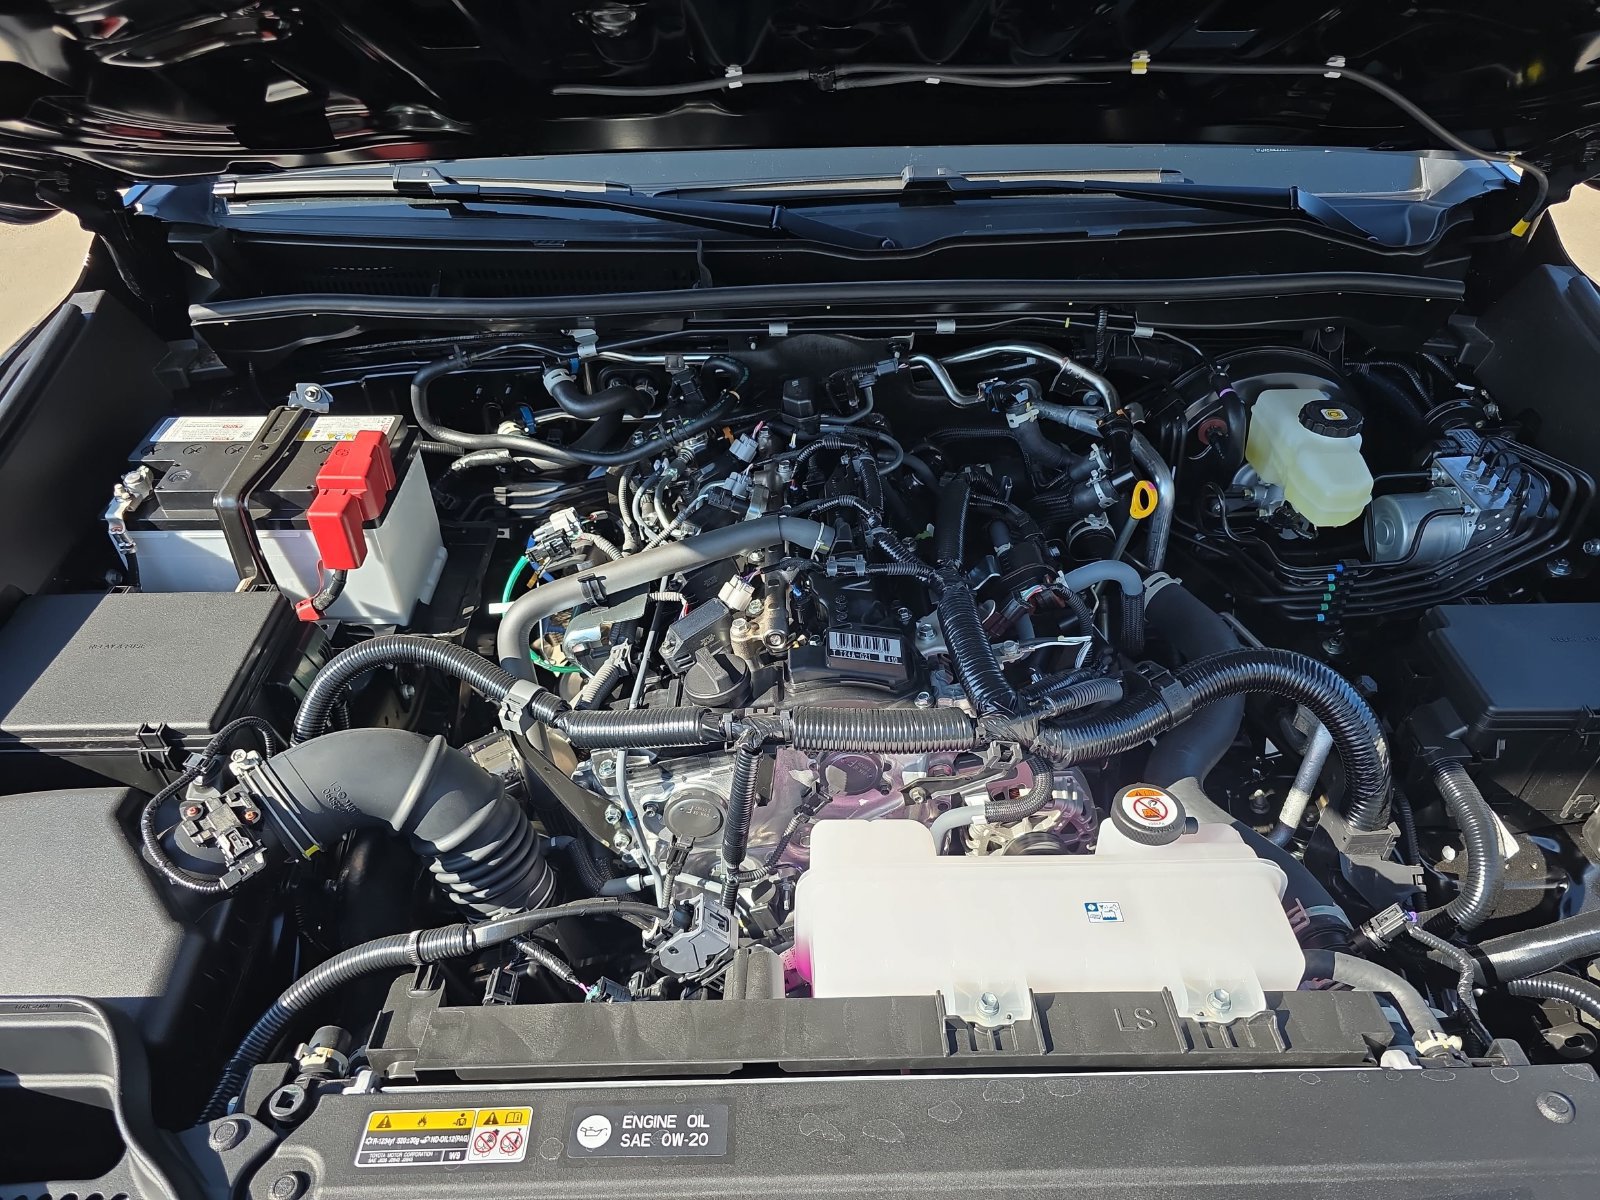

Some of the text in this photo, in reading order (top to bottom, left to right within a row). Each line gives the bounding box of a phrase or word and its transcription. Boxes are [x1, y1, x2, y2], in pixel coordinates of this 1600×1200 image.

[1113, 1007, 1158, 1031] LS
[622, 1114, 710, 1128] ENGINE OIL
[620, 1132, 709, 1147] SAE 0W-20
